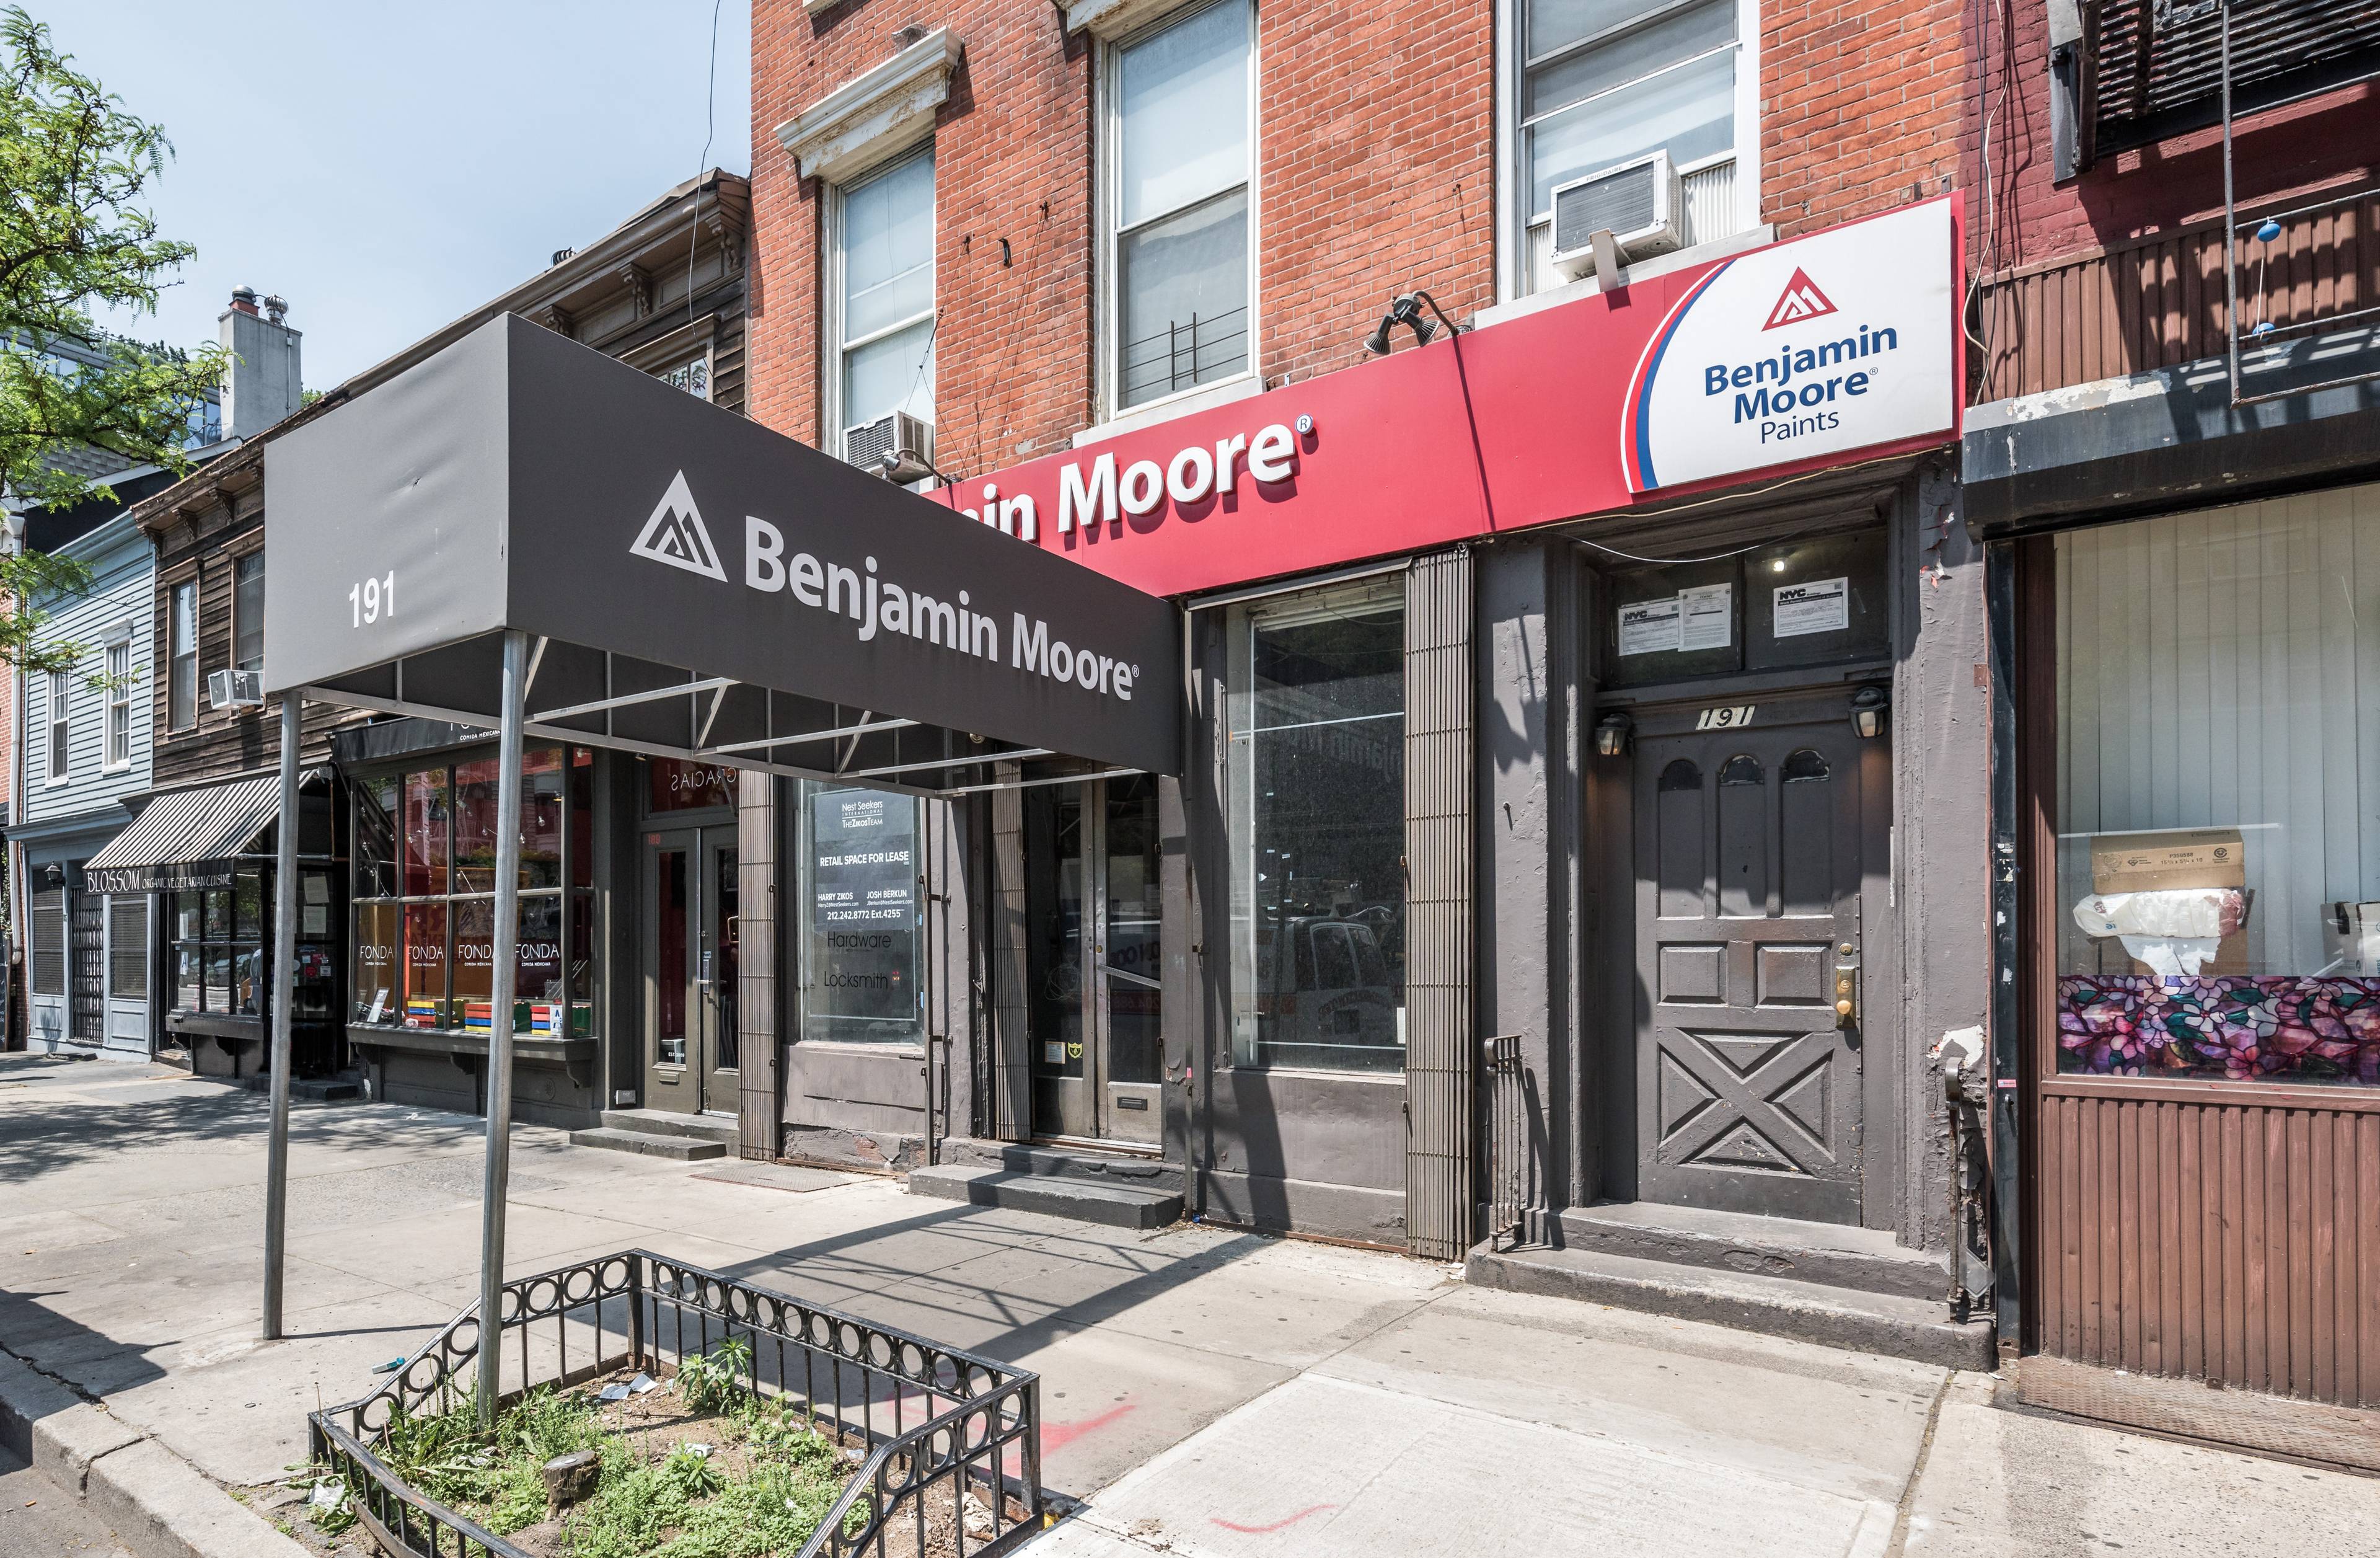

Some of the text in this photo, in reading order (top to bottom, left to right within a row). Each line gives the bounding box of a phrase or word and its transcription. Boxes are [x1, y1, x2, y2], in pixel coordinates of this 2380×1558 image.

[1586, 166, 1623, 181] FRIGIDAIRE
[1704, 324, 1897, 396] Benjamin
[1761, 411, 1840, 444] Paints
[746, 515, 998, 662] Benjamin
[1779, 588, 1806, 600] NYC
[349, 570, 394, 628] 191
[1624, 611, 1647, 621] NYC
[1703, 706, 1750, 727] 191
[479, 730, 501, 738] MEXICANA
[842, 800, 883, 812] Nest Seekers
[820, 851, 909, 867] RETAIL SPACE FOR LEASE
[87, 870, 232, 893] BLOSSOM ORGANIC VEGETARIAN CUISINE
[818, 892, 853, 901] HARRY ZIKOS
[866, 890, 907, 899] JOSH BERKUN
[827, 910, 901, 920] 212.242.8772 Ext.4255
[827, 931, 891, 948] Hardware
[360, 945, 394, 960] FONDA
[408, 946, 444, 960] FONDA
[459, 944, 495, 959] FOND
[824, 971, 888, 989] Locksmith
